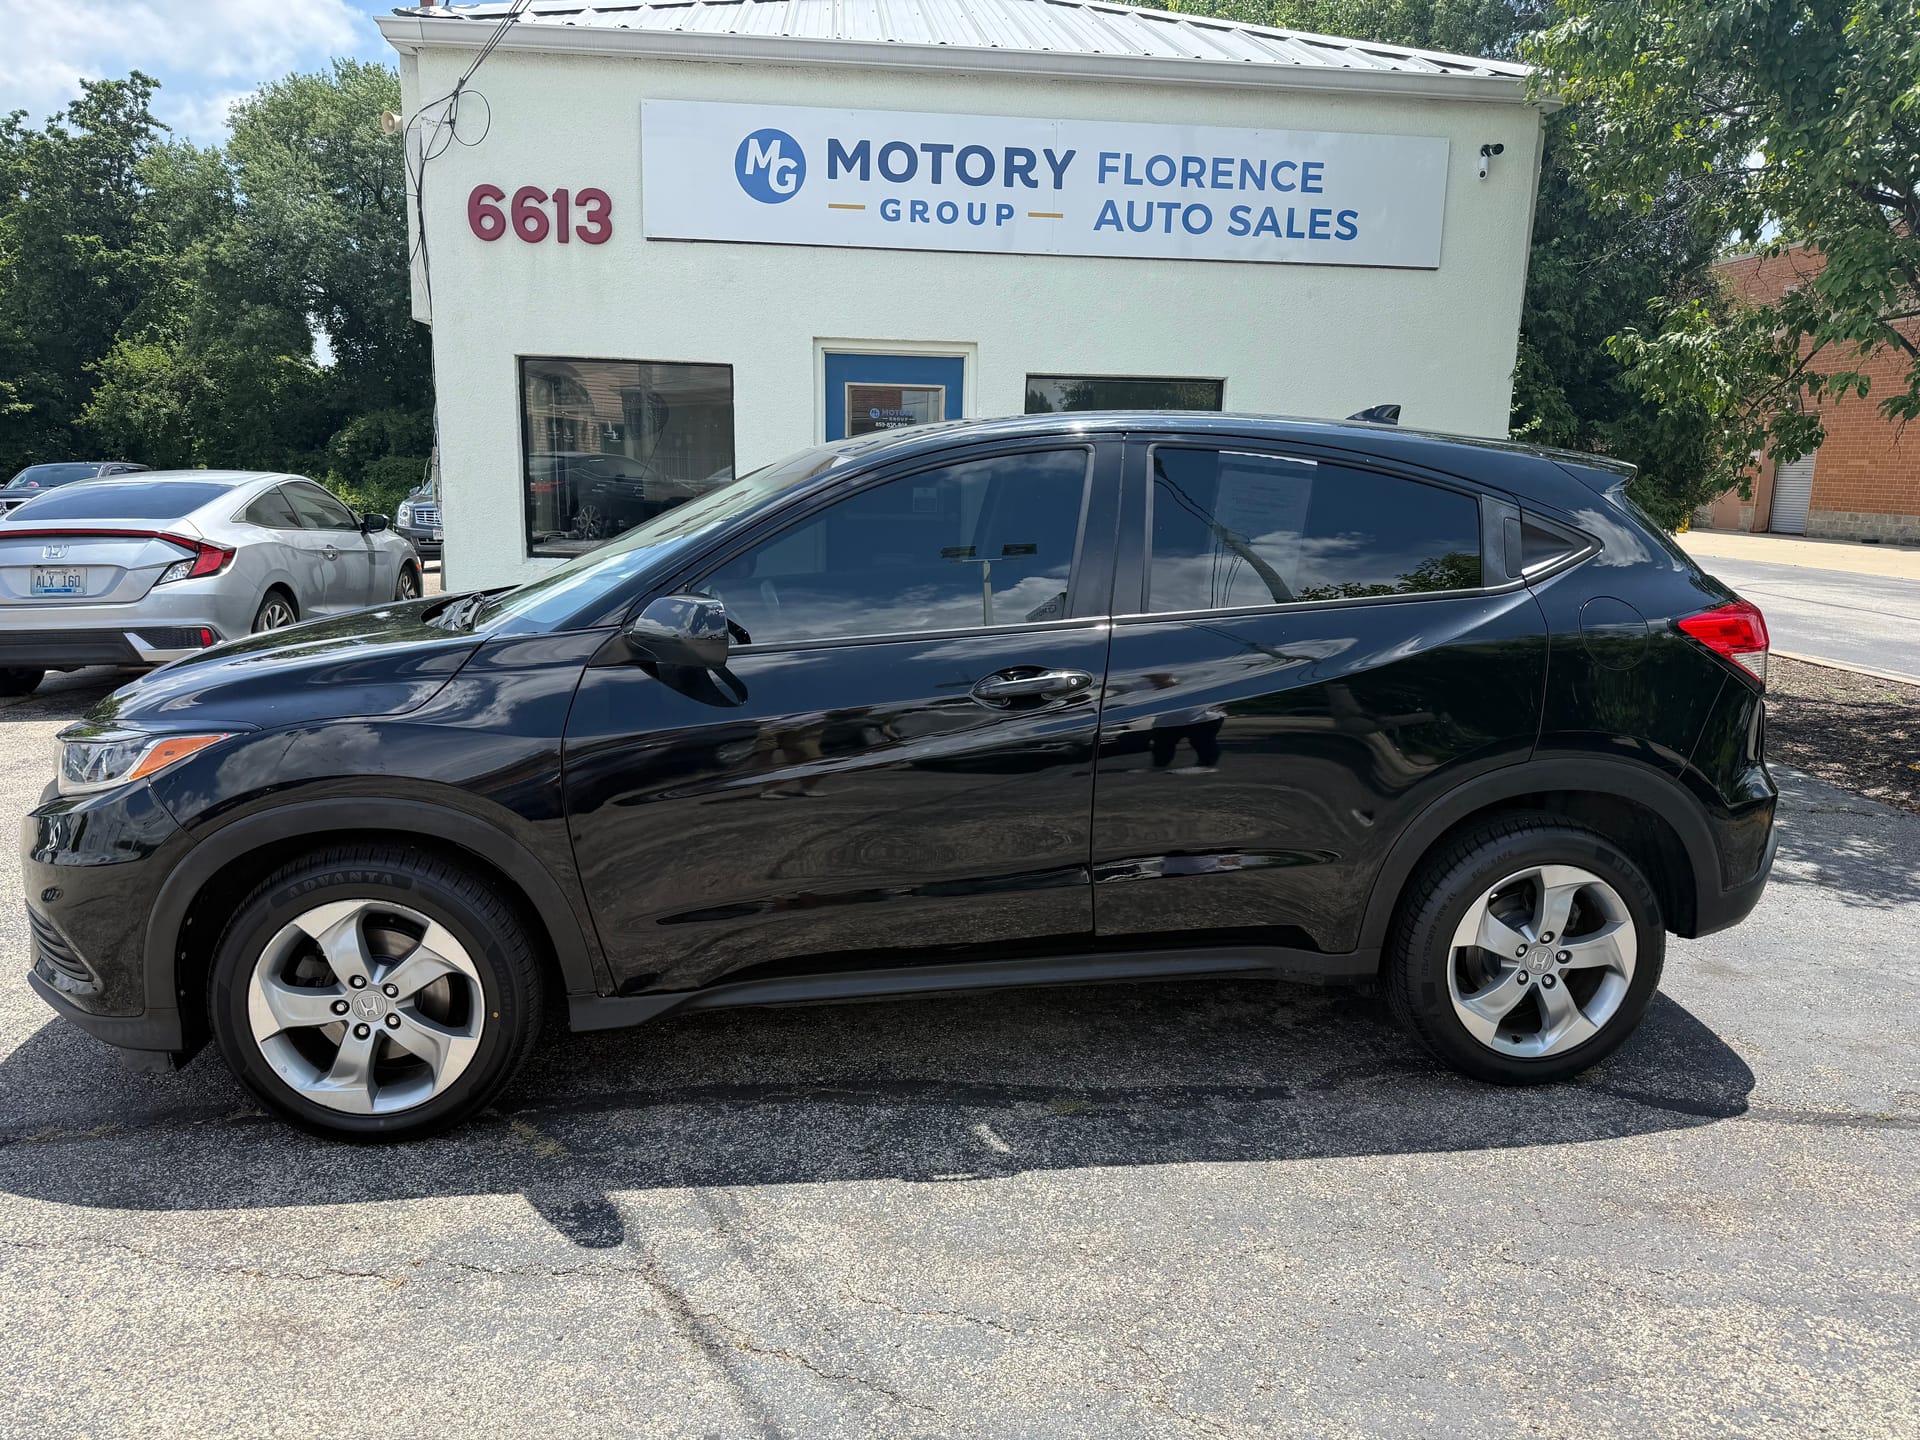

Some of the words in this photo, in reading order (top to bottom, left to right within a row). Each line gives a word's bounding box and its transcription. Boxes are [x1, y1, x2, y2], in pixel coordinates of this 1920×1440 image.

[745, 138, 798, 194] MG
[827, 138, 1076, 190] MOTORY
[1098, 152, 1325, 193] FLORENCE
[468, 184, 612, 244] 6613
[880, 198, 1015, 226] GROUP
[1093, 199, 1213, 235] AUTO
[1227, 205, 1359, 240] SALES
[36, 575, 54, 588] ALX
[62, 575, 81, 588] 160
[286, 871, 393, 898] ADVANTA
